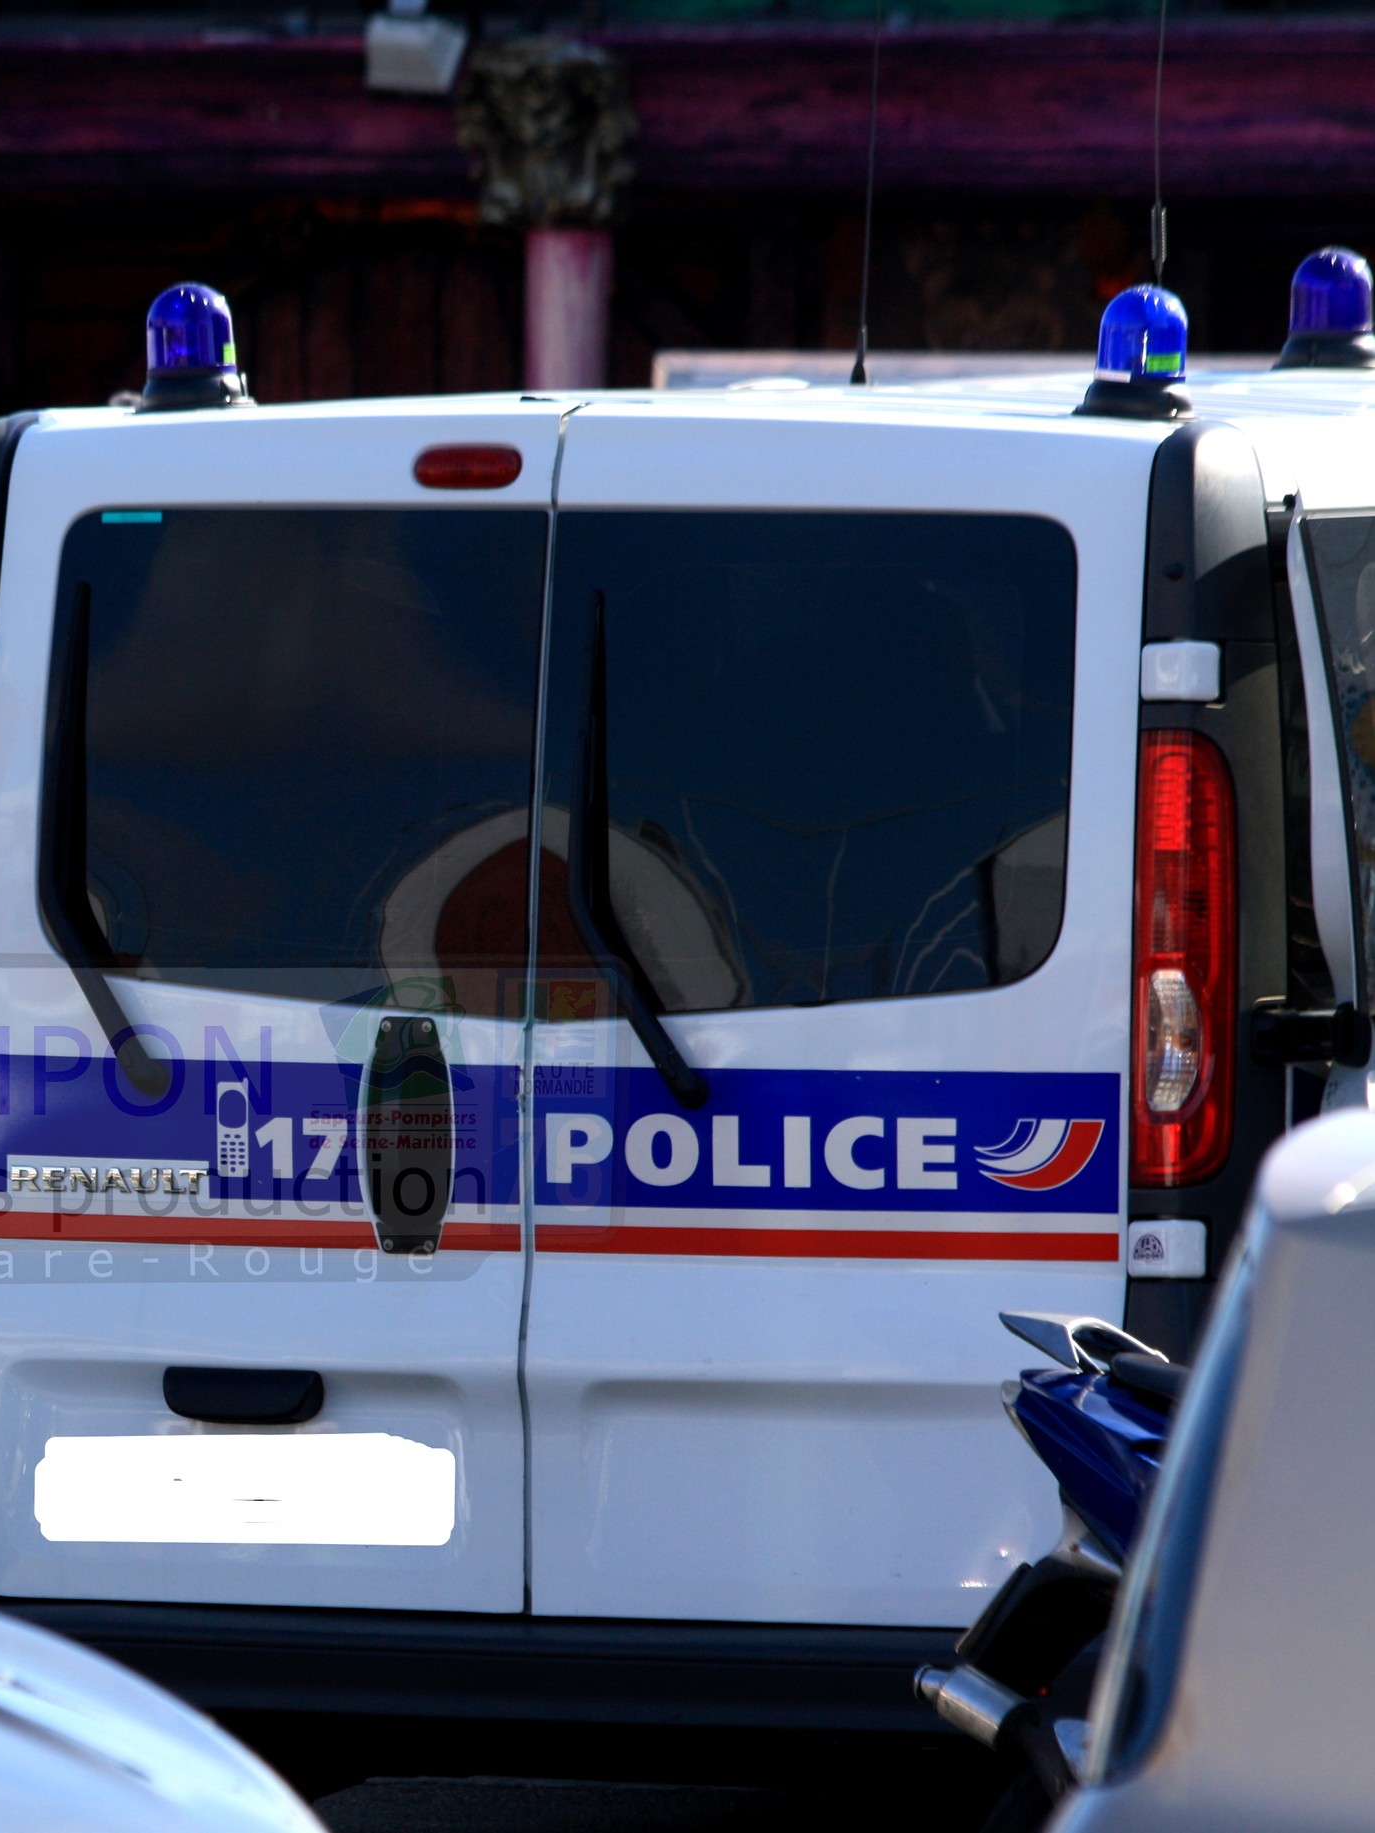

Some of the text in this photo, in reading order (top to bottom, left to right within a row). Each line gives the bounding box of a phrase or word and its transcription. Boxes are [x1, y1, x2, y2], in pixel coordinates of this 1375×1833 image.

[10, 1165, 208, 1194] RENAULT
[255, 1117, 348, 1181] 17
[546, 1112, 957, 1191] POLICE
